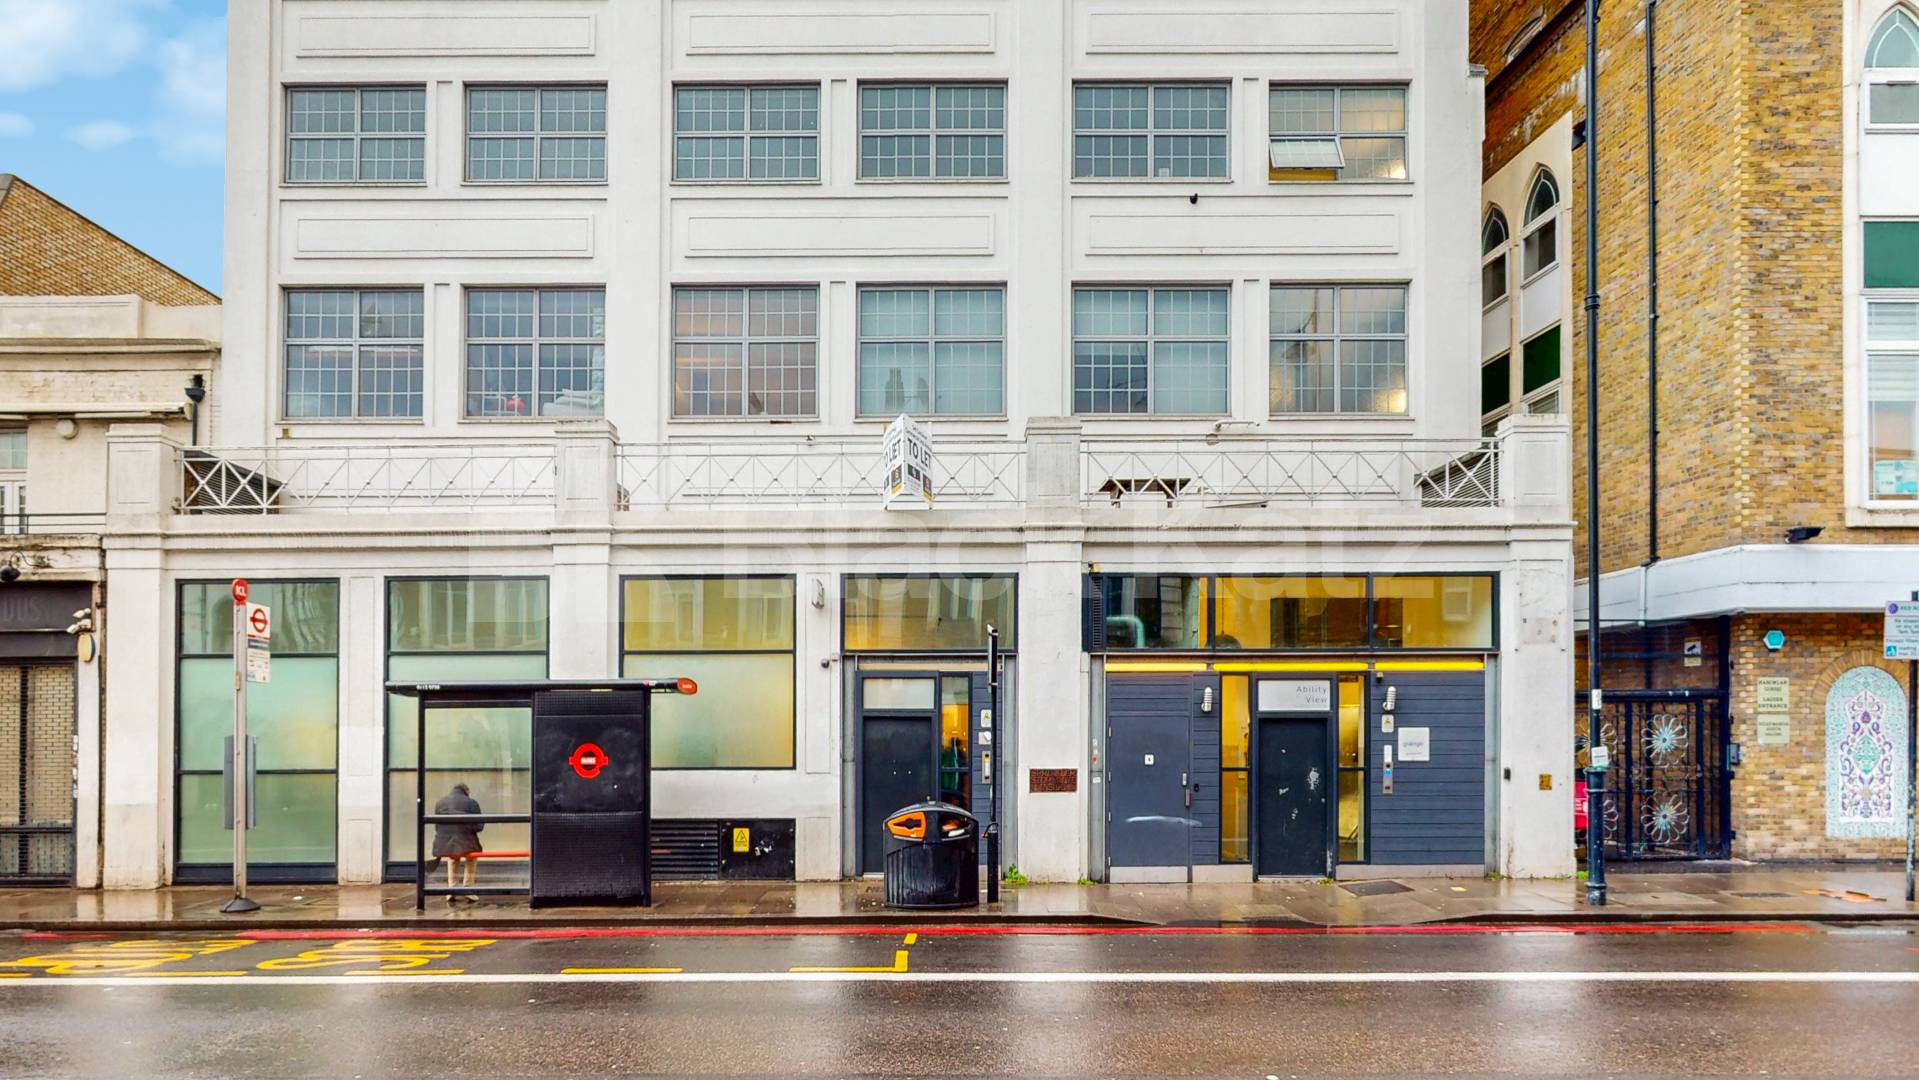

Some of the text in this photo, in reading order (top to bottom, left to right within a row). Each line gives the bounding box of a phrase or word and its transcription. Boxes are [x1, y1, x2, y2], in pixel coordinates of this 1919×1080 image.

[907, 436, 932, 470] TO LET
[1296, 686, 1328, 694] Ability
[1305, 695, 1328, 703] View
